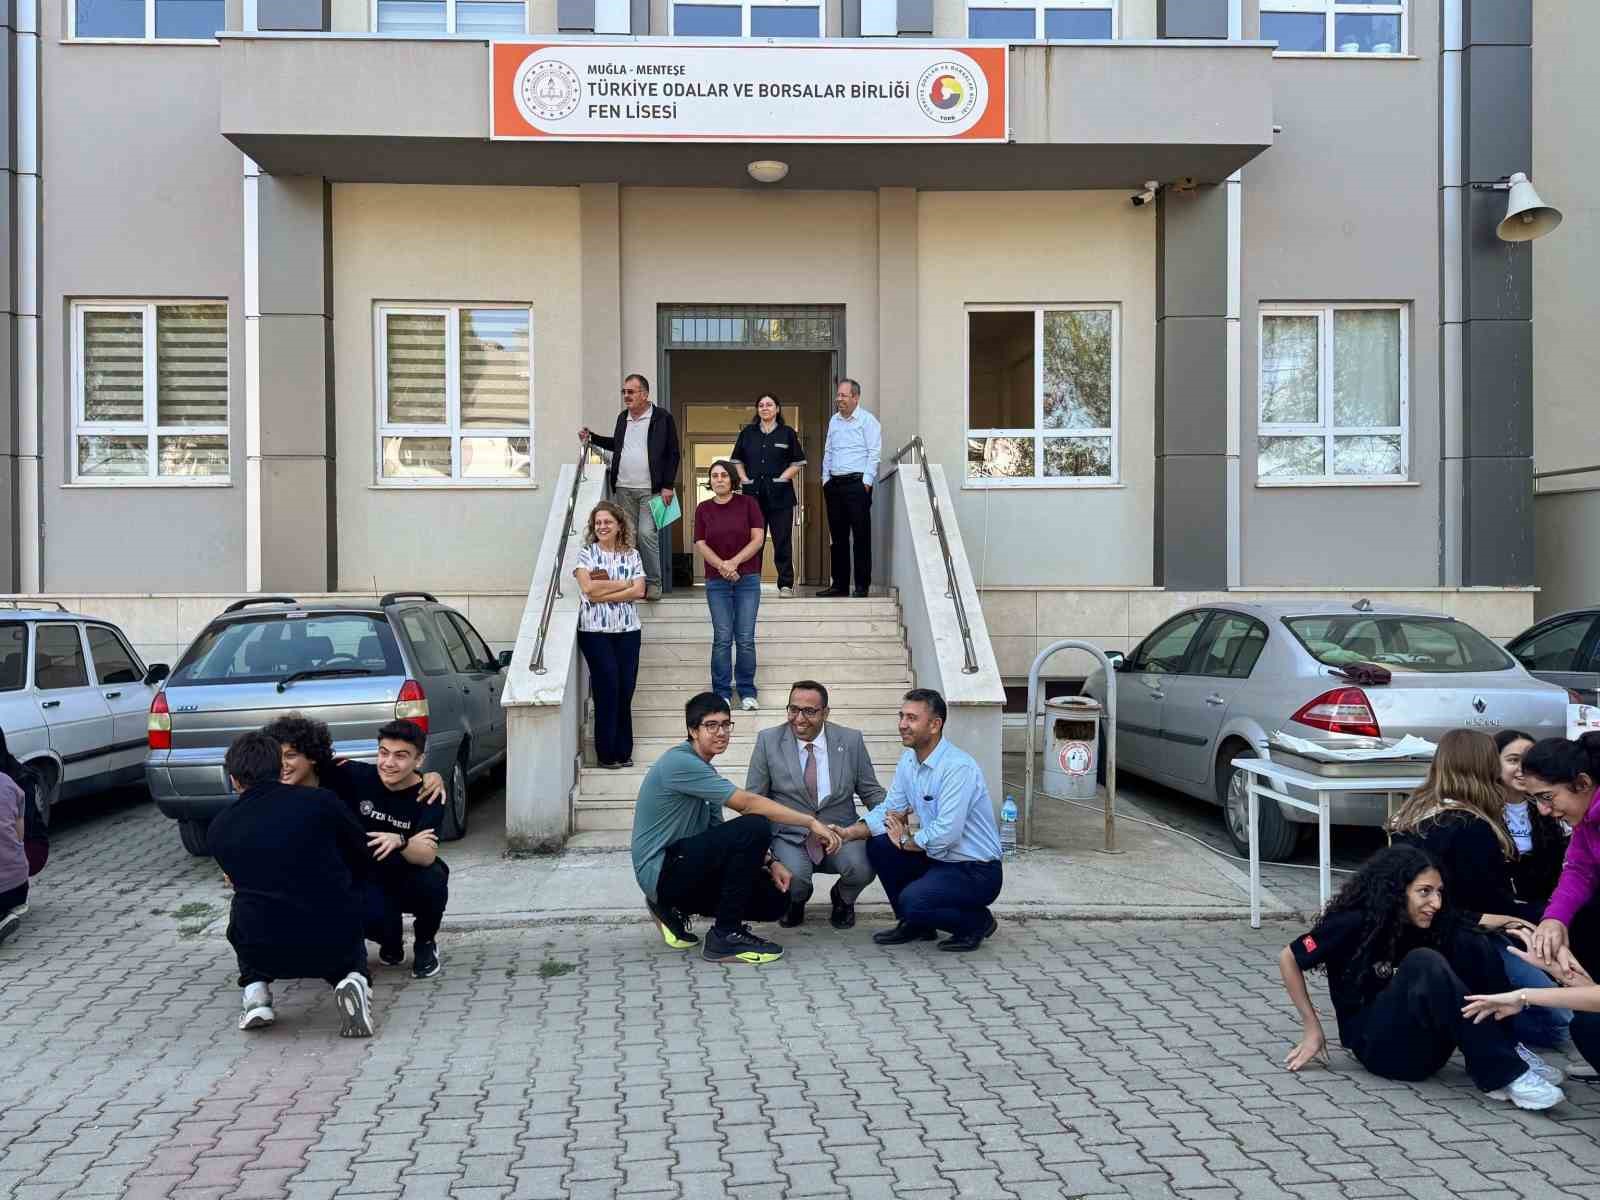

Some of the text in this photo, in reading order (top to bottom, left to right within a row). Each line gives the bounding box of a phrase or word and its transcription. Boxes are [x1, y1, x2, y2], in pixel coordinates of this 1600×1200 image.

[588, 63, 626, 74] MUĞLA
[637, 65, 685, 76] MENTEŞE
[588, 79, 909, 98] TÜRKİYE ODALAR VE BORSALAR BİRLİĞİ
[589, 102, 676, 118] FEN LİSESİ
